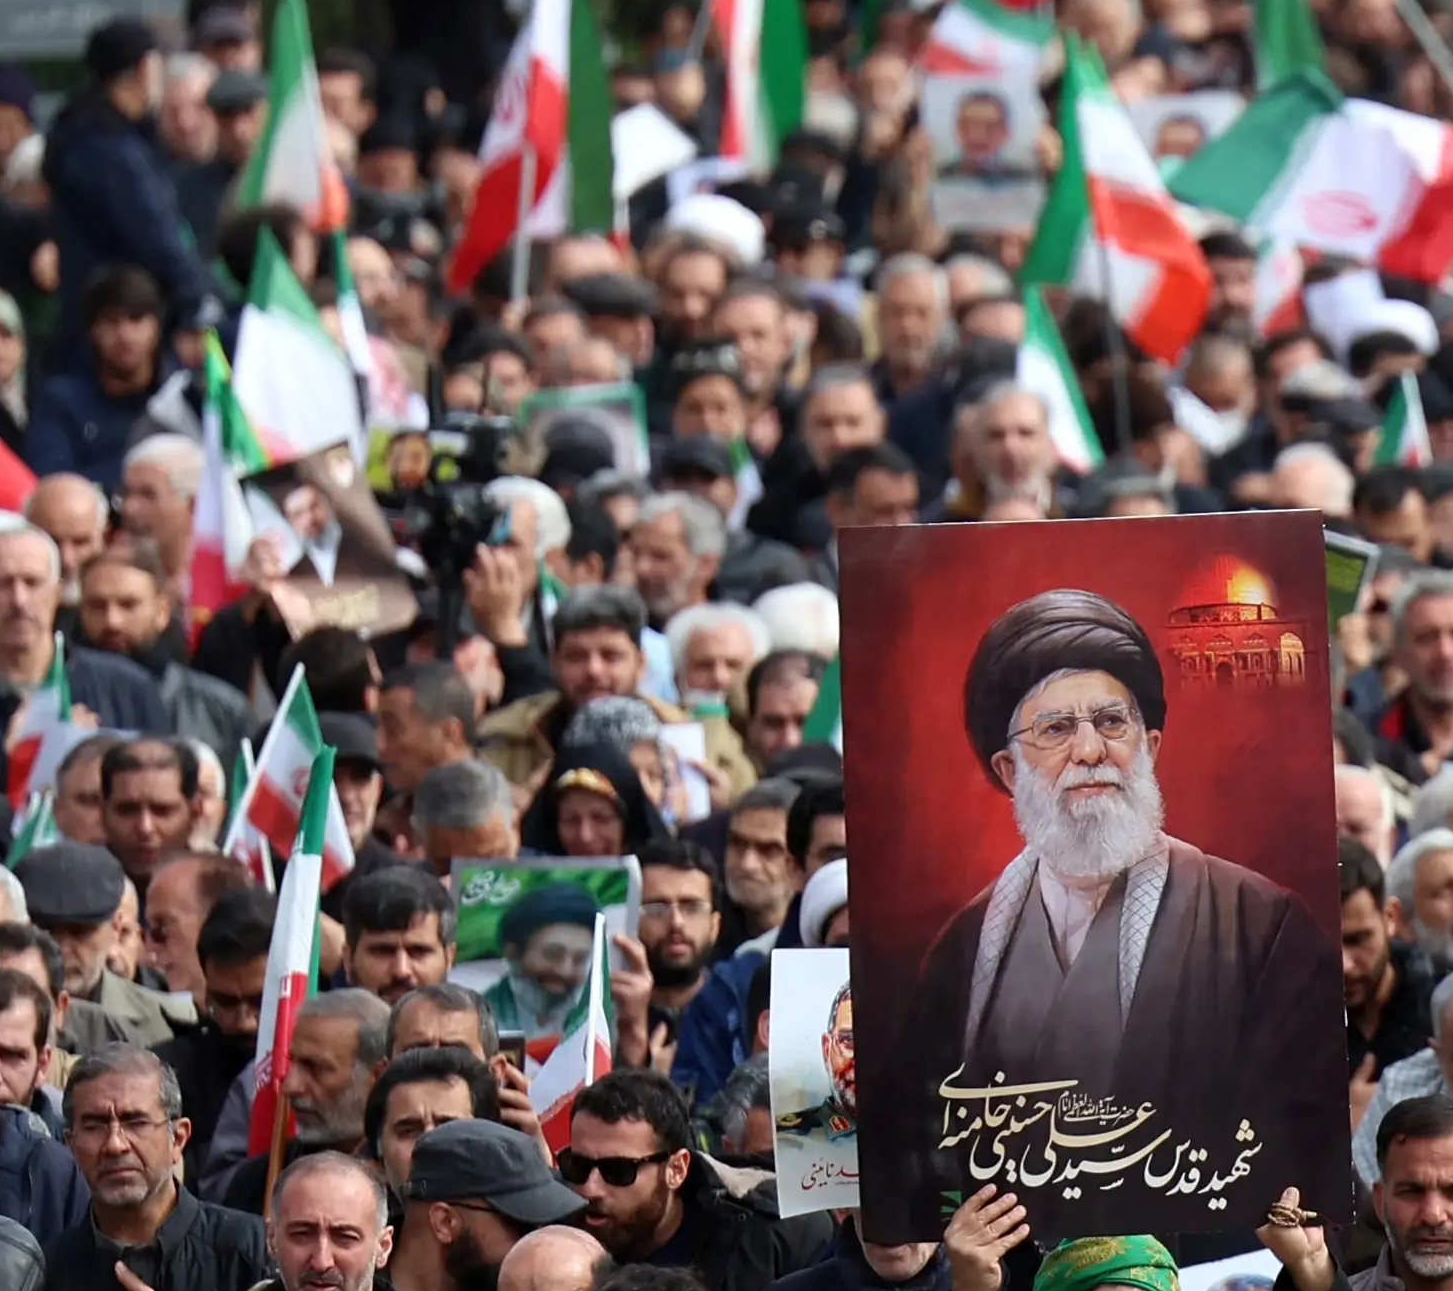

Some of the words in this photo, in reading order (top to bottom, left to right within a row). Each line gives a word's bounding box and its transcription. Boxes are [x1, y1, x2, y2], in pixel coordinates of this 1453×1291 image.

[969, 1095, 1052, 1183] حسینی
[1020, 1101, 1156, 1186] علی
[1143, 1137, 1208, 1196] قدس
[1198, 1119, 1263, 1210] شهید
